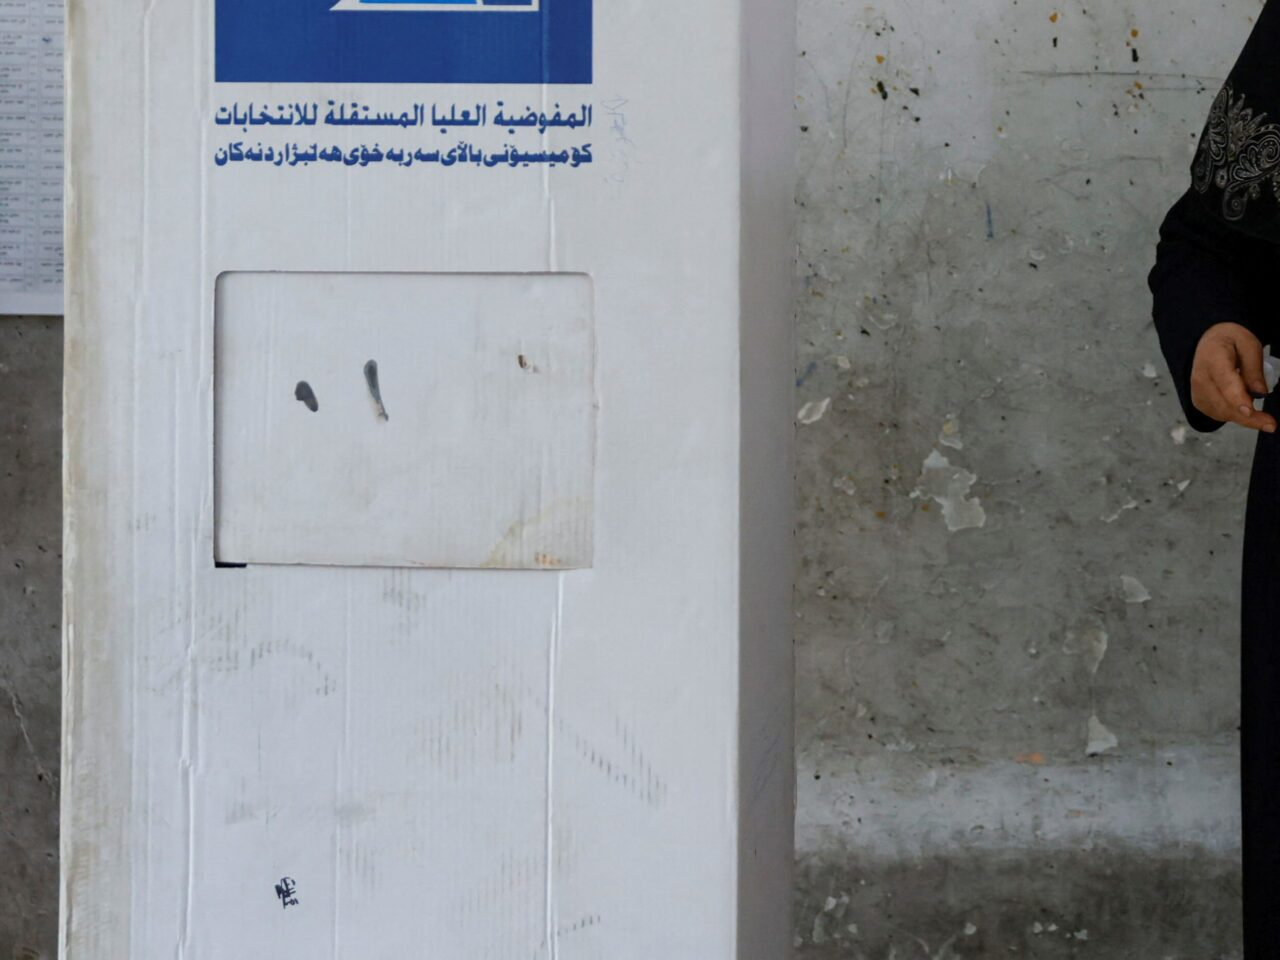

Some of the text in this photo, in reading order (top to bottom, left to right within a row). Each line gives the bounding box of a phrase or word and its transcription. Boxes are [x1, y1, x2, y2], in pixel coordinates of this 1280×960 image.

[214, 99, 593, 134] المفوضية العليا المستقلة للانتخابات
